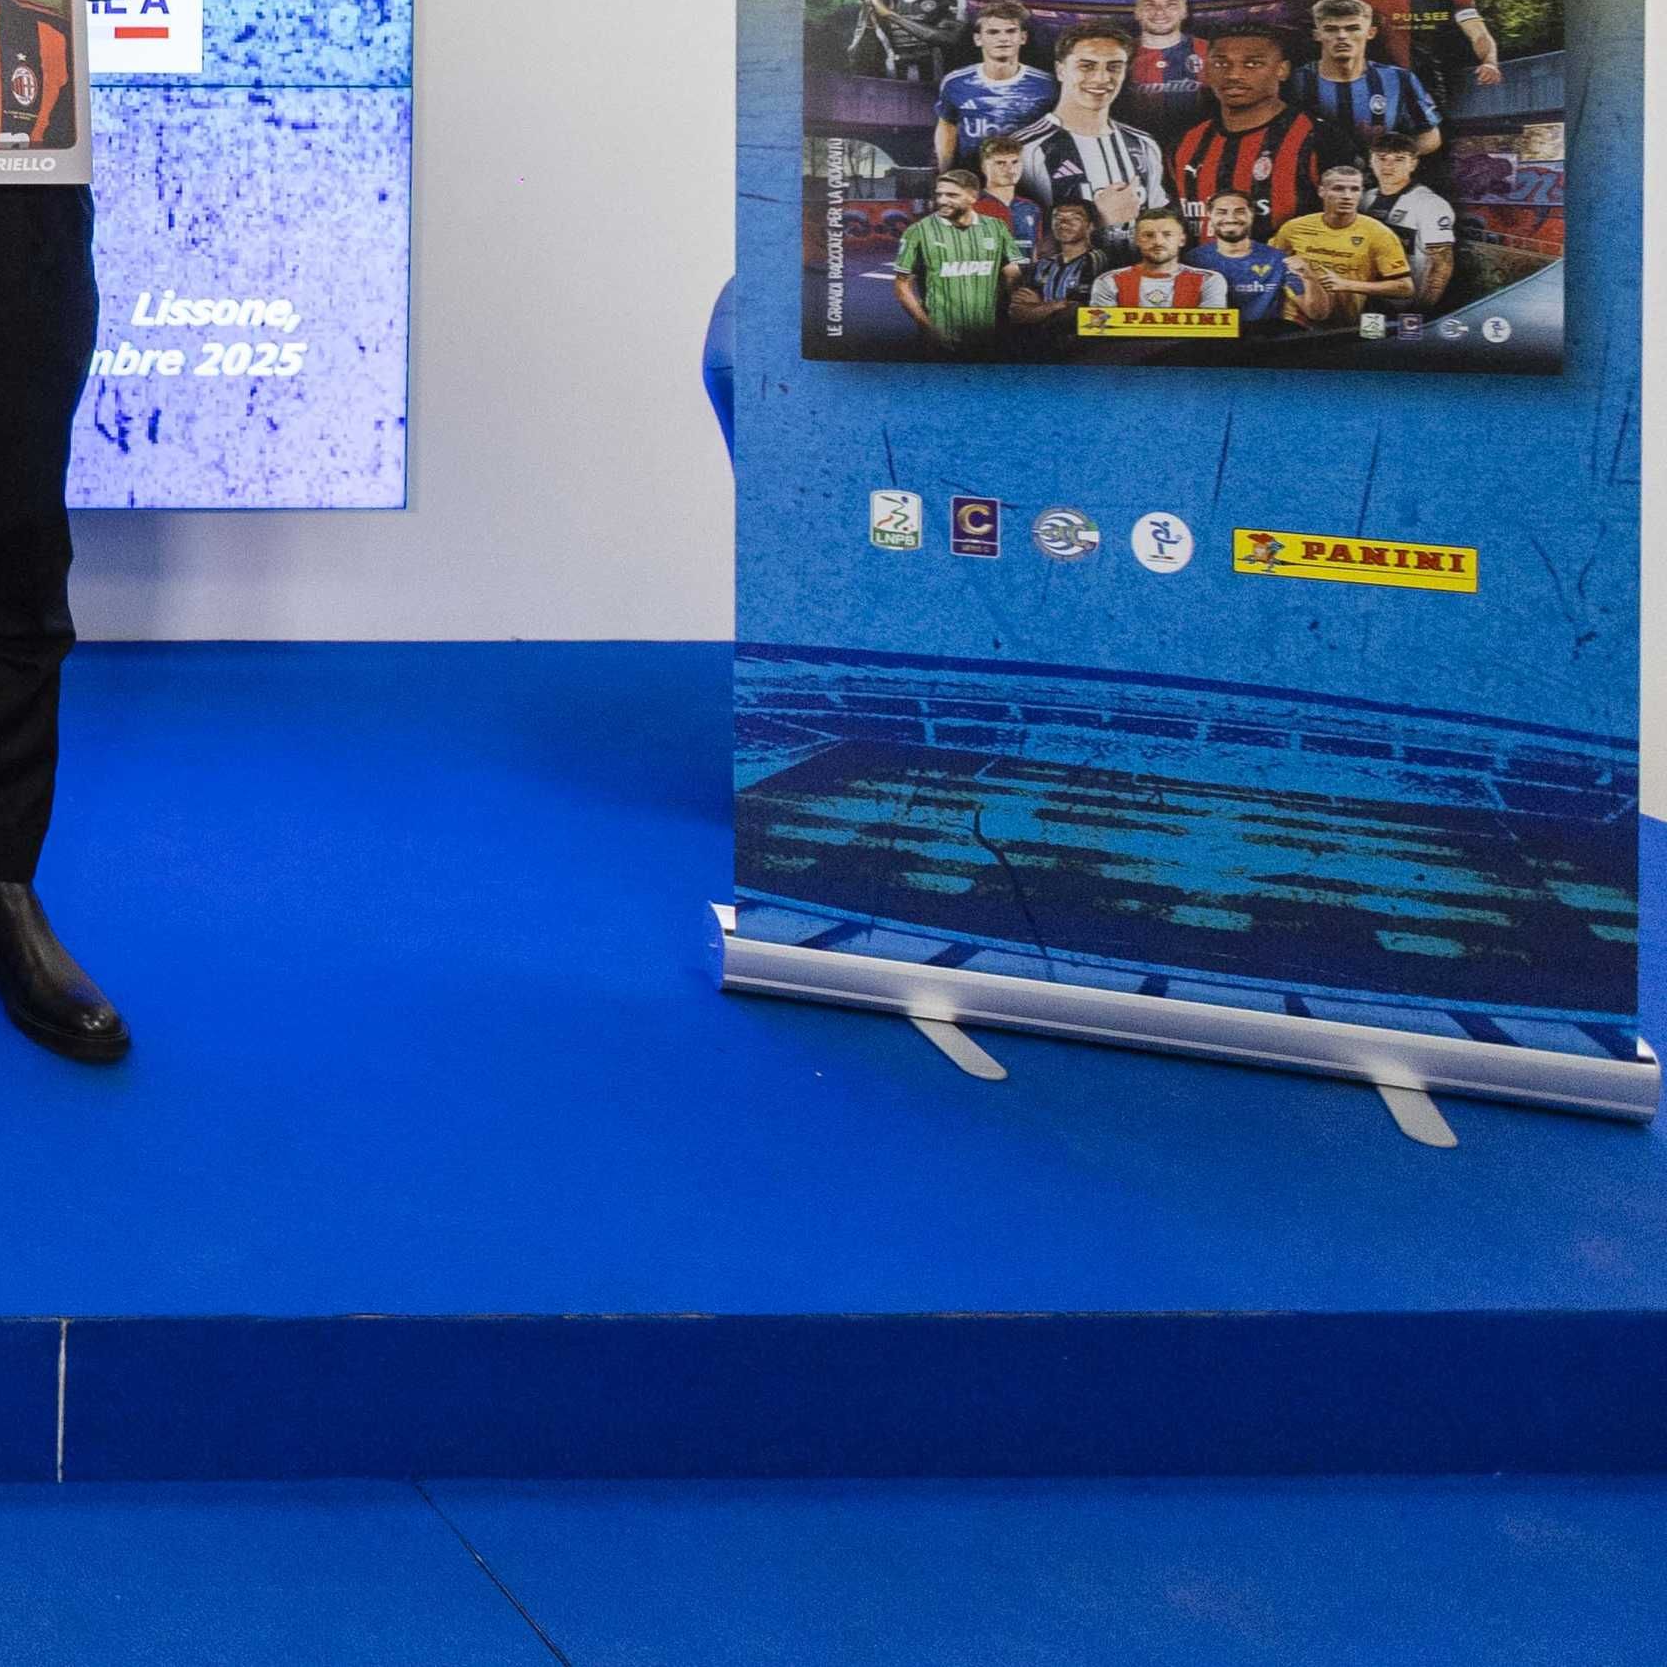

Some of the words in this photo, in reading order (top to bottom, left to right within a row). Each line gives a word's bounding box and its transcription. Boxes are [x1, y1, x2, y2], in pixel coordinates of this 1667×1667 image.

[1392, 12, 1450, 23] PULSEE
[827, 189, 844, 205] LA
[827, 207, 844, 228] PER
[939, 260, 995, 278] MAPEI
[130, 289, 302, 334] Lissone,
[1122, 310, 1232, 326] PANINI
[827, 324, 843, 337] LE
[192, 341, 310, 377] 2025
[874, 532, 917, 547] LNPB
[1300, 540, 1466, 573] PANINI
